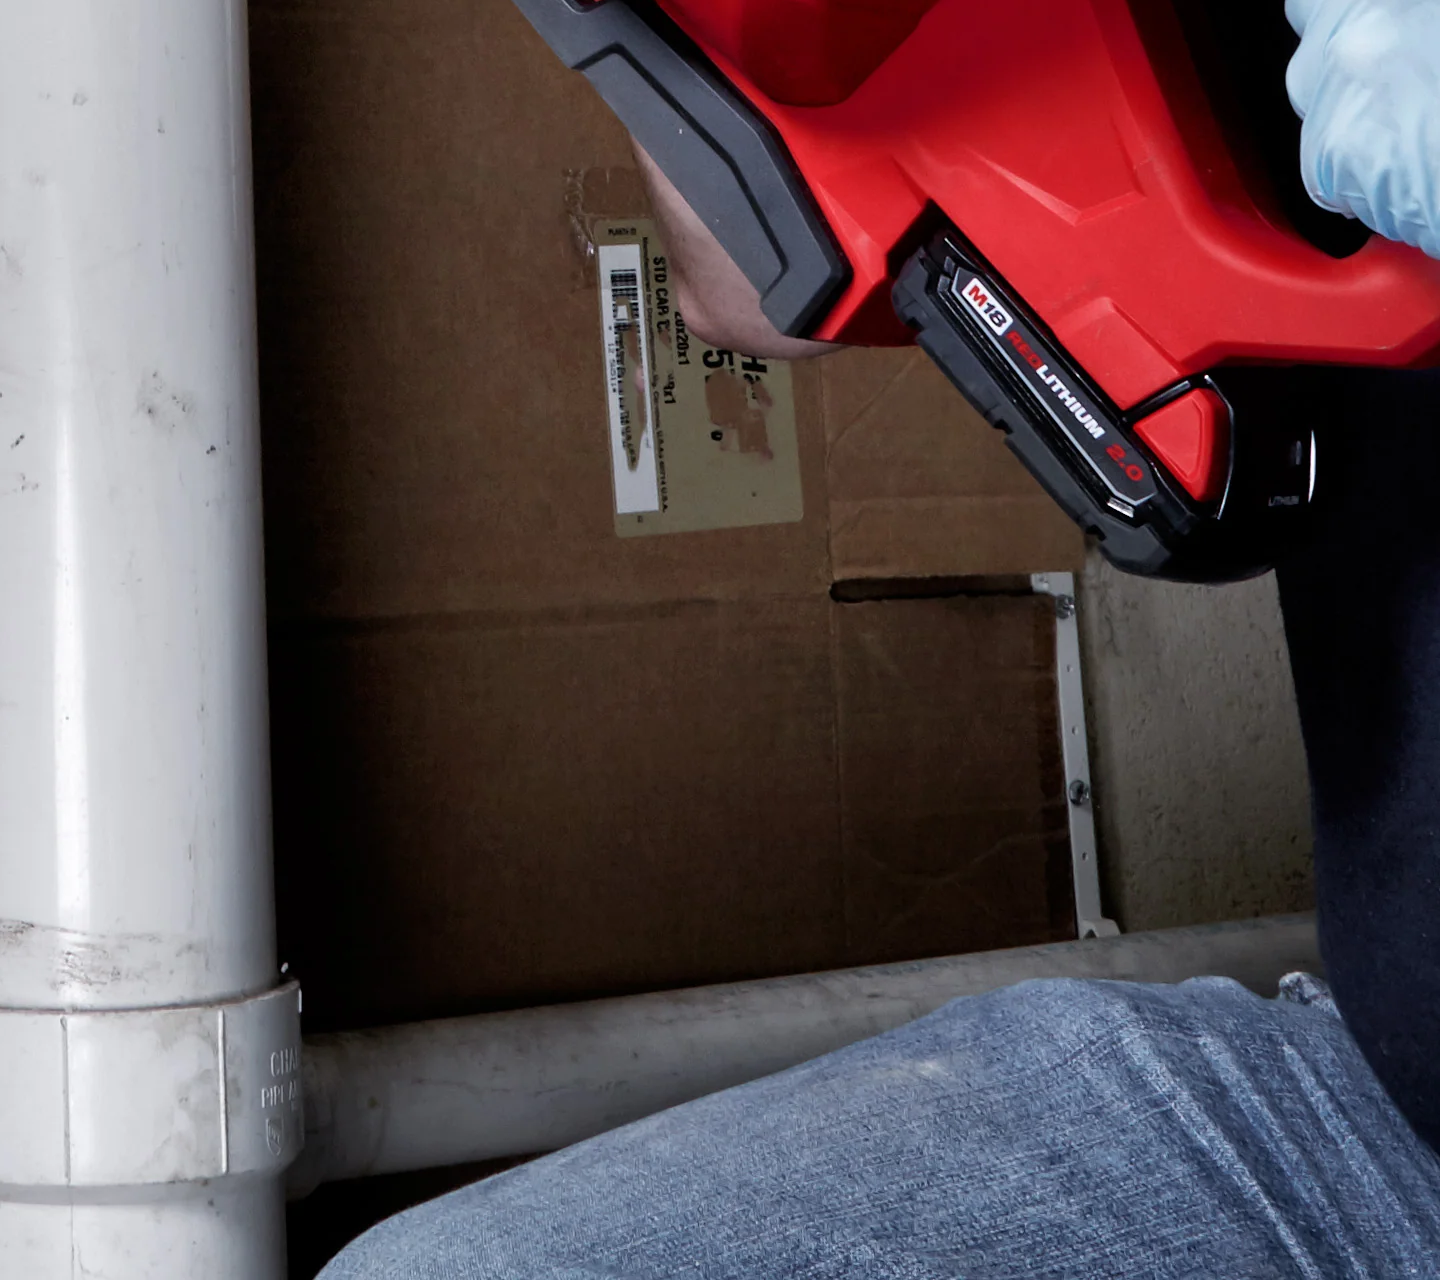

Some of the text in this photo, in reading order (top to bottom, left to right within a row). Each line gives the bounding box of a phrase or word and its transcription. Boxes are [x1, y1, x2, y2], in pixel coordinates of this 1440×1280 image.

[653, 256, 668, 283] STD
[969, 284, 1144, 482] M18 REDLITHIUM 2.0
